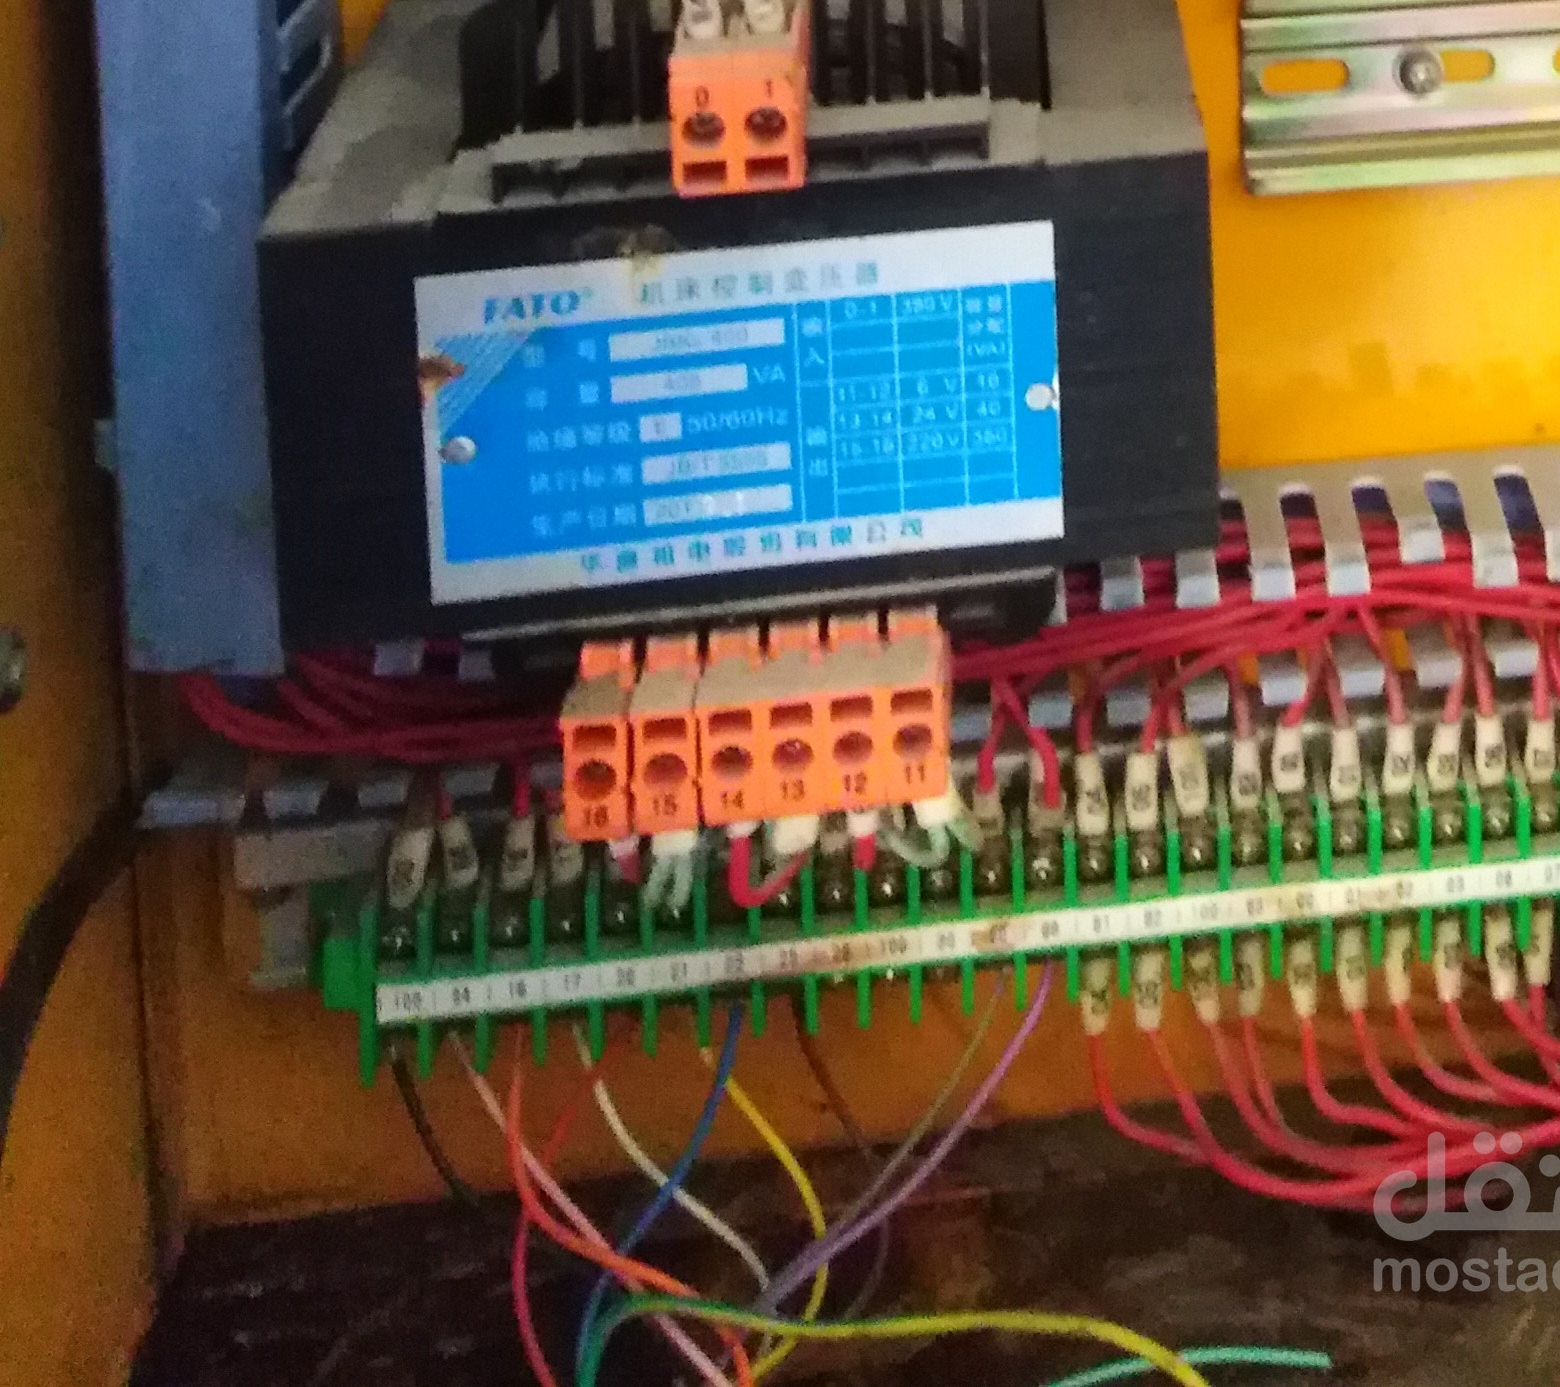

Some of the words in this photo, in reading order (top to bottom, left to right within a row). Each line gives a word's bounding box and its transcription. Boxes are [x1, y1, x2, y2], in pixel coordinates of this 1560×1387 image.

[694, 85, 711, 109] 0
[764, 80, 773, 98] 1
[483, 288, 582, 326] FATO
[753, 364, 786, 384] VA
[843, 771, 868, 796] 12
[904, 761, 926, 785] 11
[720, 787, 745, 811] 14
[780, 777, 806, 801] 13
[652, 793, 678, 817] 15
